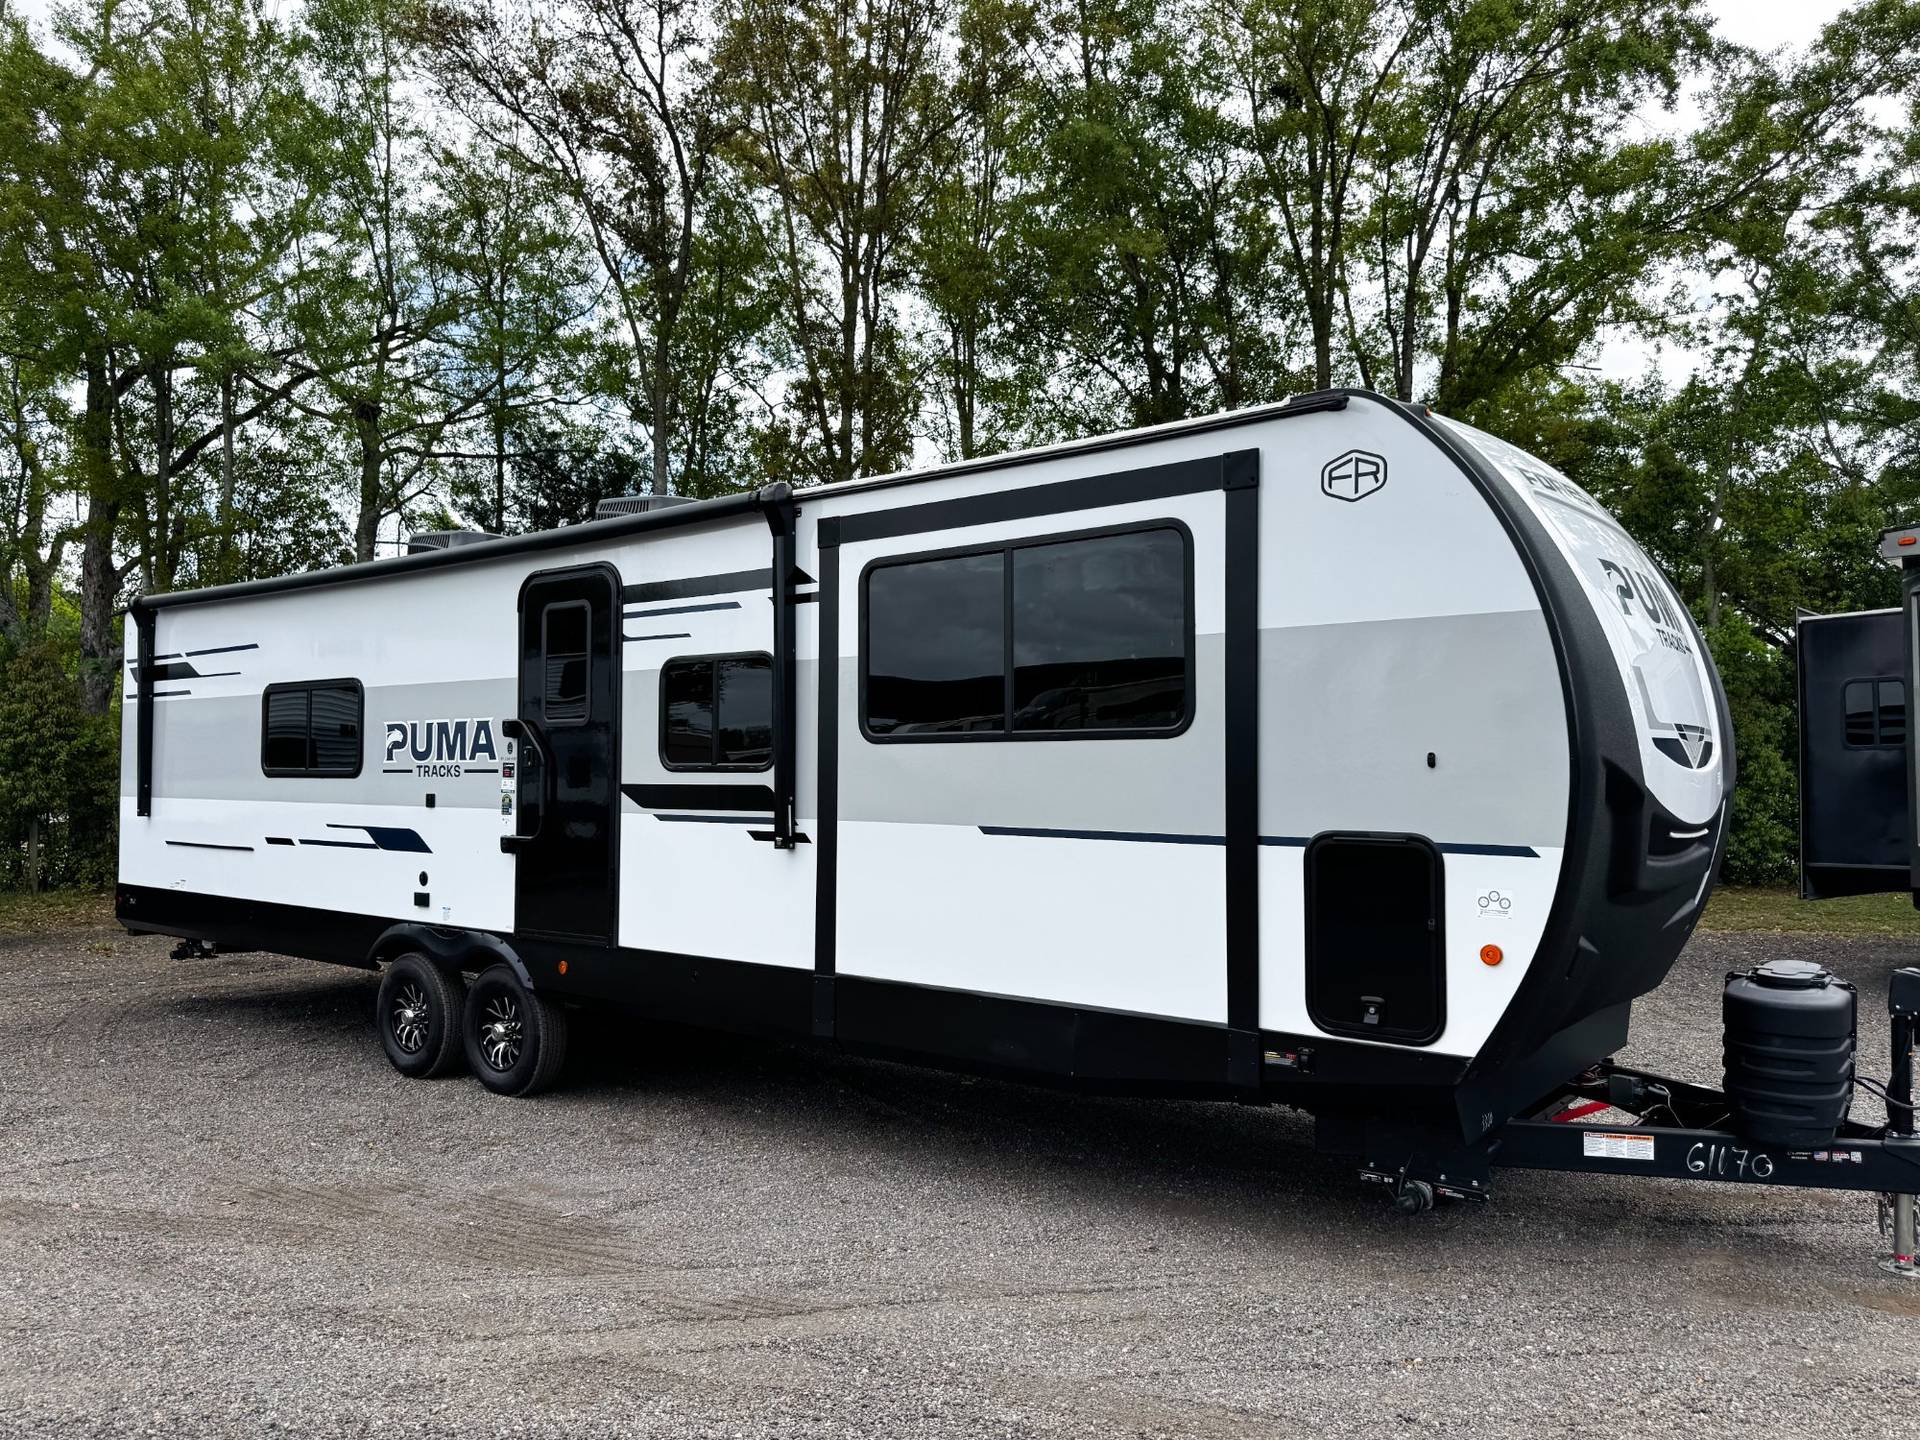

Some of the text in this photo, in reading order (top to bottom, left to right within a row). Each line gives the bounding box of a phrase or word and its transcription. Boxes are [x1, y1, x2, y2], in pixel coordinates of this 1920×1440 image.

[1328, 457, 1380, 494] FR
[384, 718, 498, 763] PUMA
[416, 764, 461, 778] TRACKS
[1686, 1142, 1773, 1177] 61170
